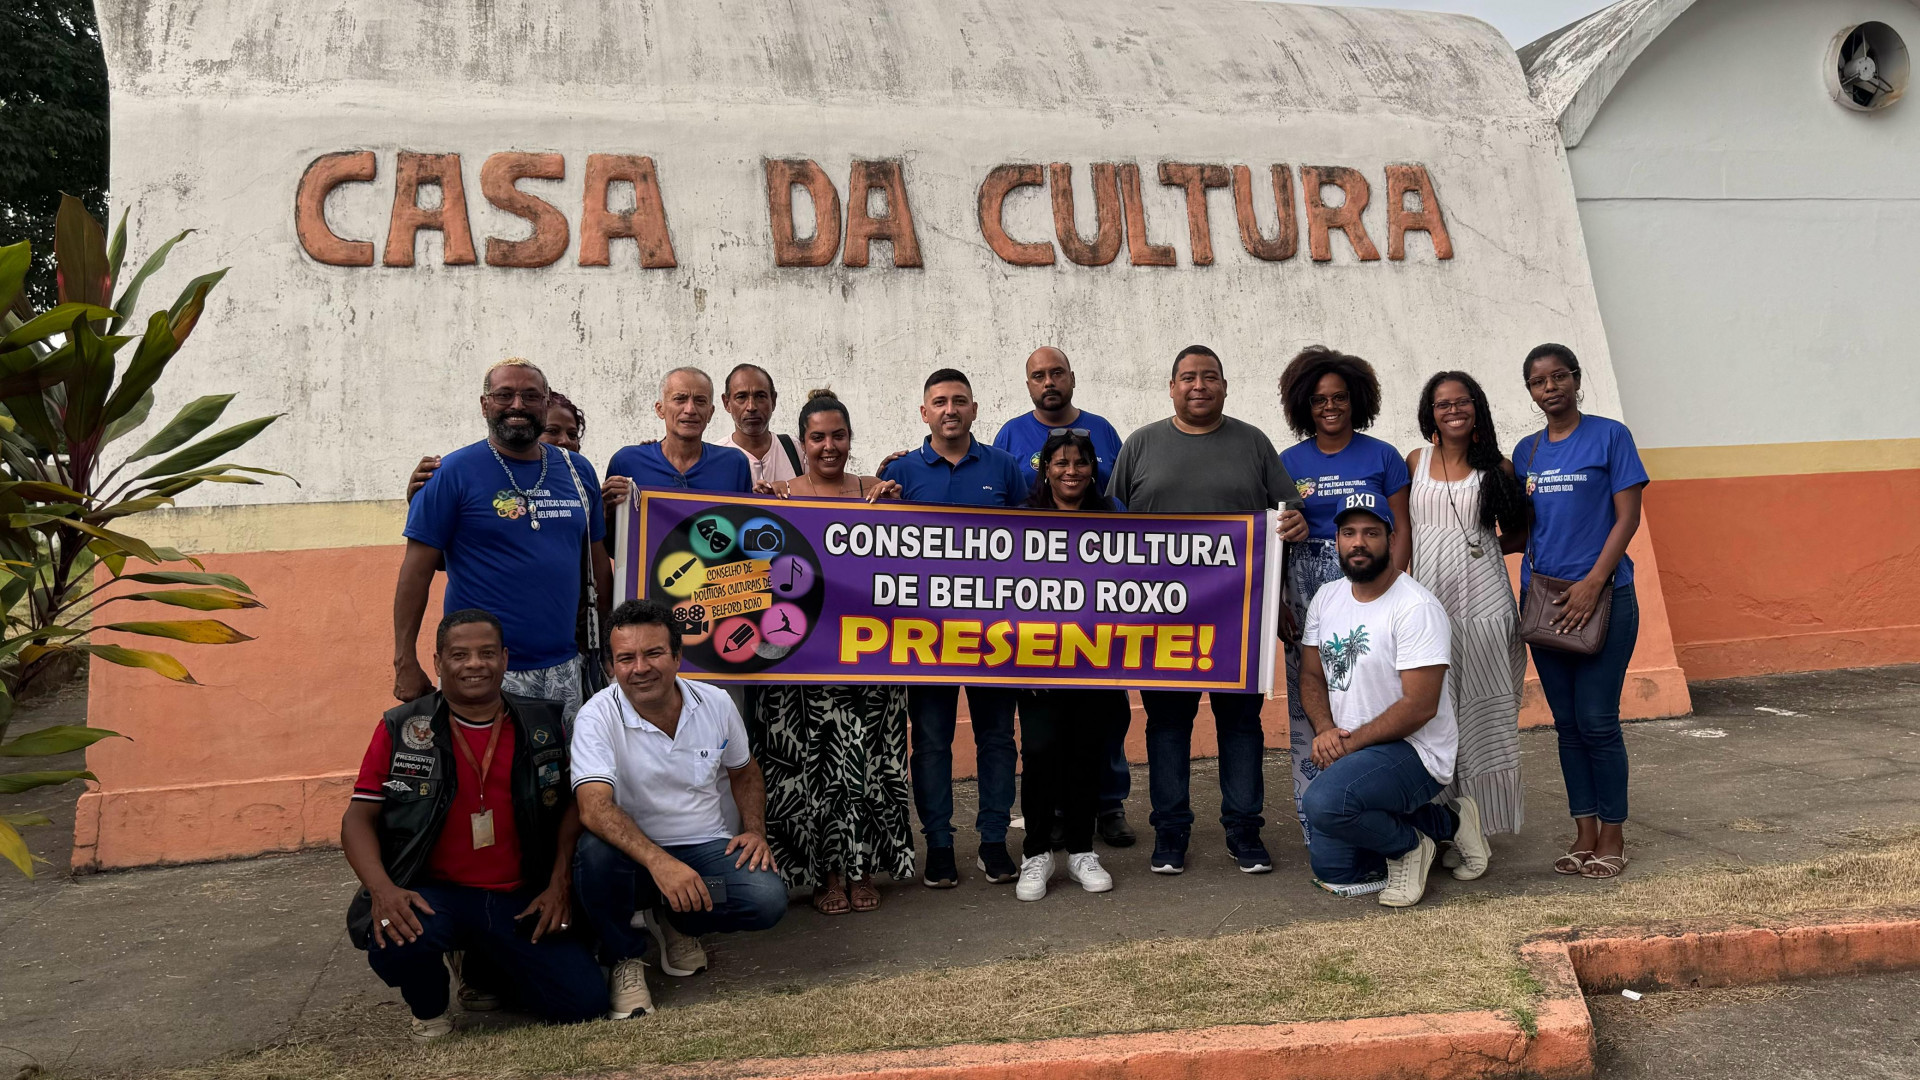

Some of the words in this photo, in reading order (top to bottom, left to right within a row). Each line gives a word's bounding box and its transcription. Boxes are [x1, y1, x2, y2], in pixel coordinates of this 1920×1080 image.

[296, 150, 678, 268] CASA
[766, 156, 924, 268] DA
[979, 162, 1454, 266] CULTURA
[1346, 493, 1375, 508] BXD
[824, 522, 1013, 560] CONSELHO
[1024, 529, 1068, 562] DE
[1078, 531, 1237, 567] CULTURA
[706, 566, 742, 581] CONSELHO
[743, 562, 753, 574] DE
[728, 578, 762, 596] CULTURAIS
[763, 576, 772, 588] DE
[873, 574, 918, 607] DE
[929, 576, 1086, 611] BELFORD
[1096, 581, 1187, 614] ROXO
[712, 602, 742, 617] BELFORD
[744, 597, 762, 609] ROXO
[839, 615, 1215, 671] PRESENTE!
[396, 753, 433, 764] PRESIDENTE
